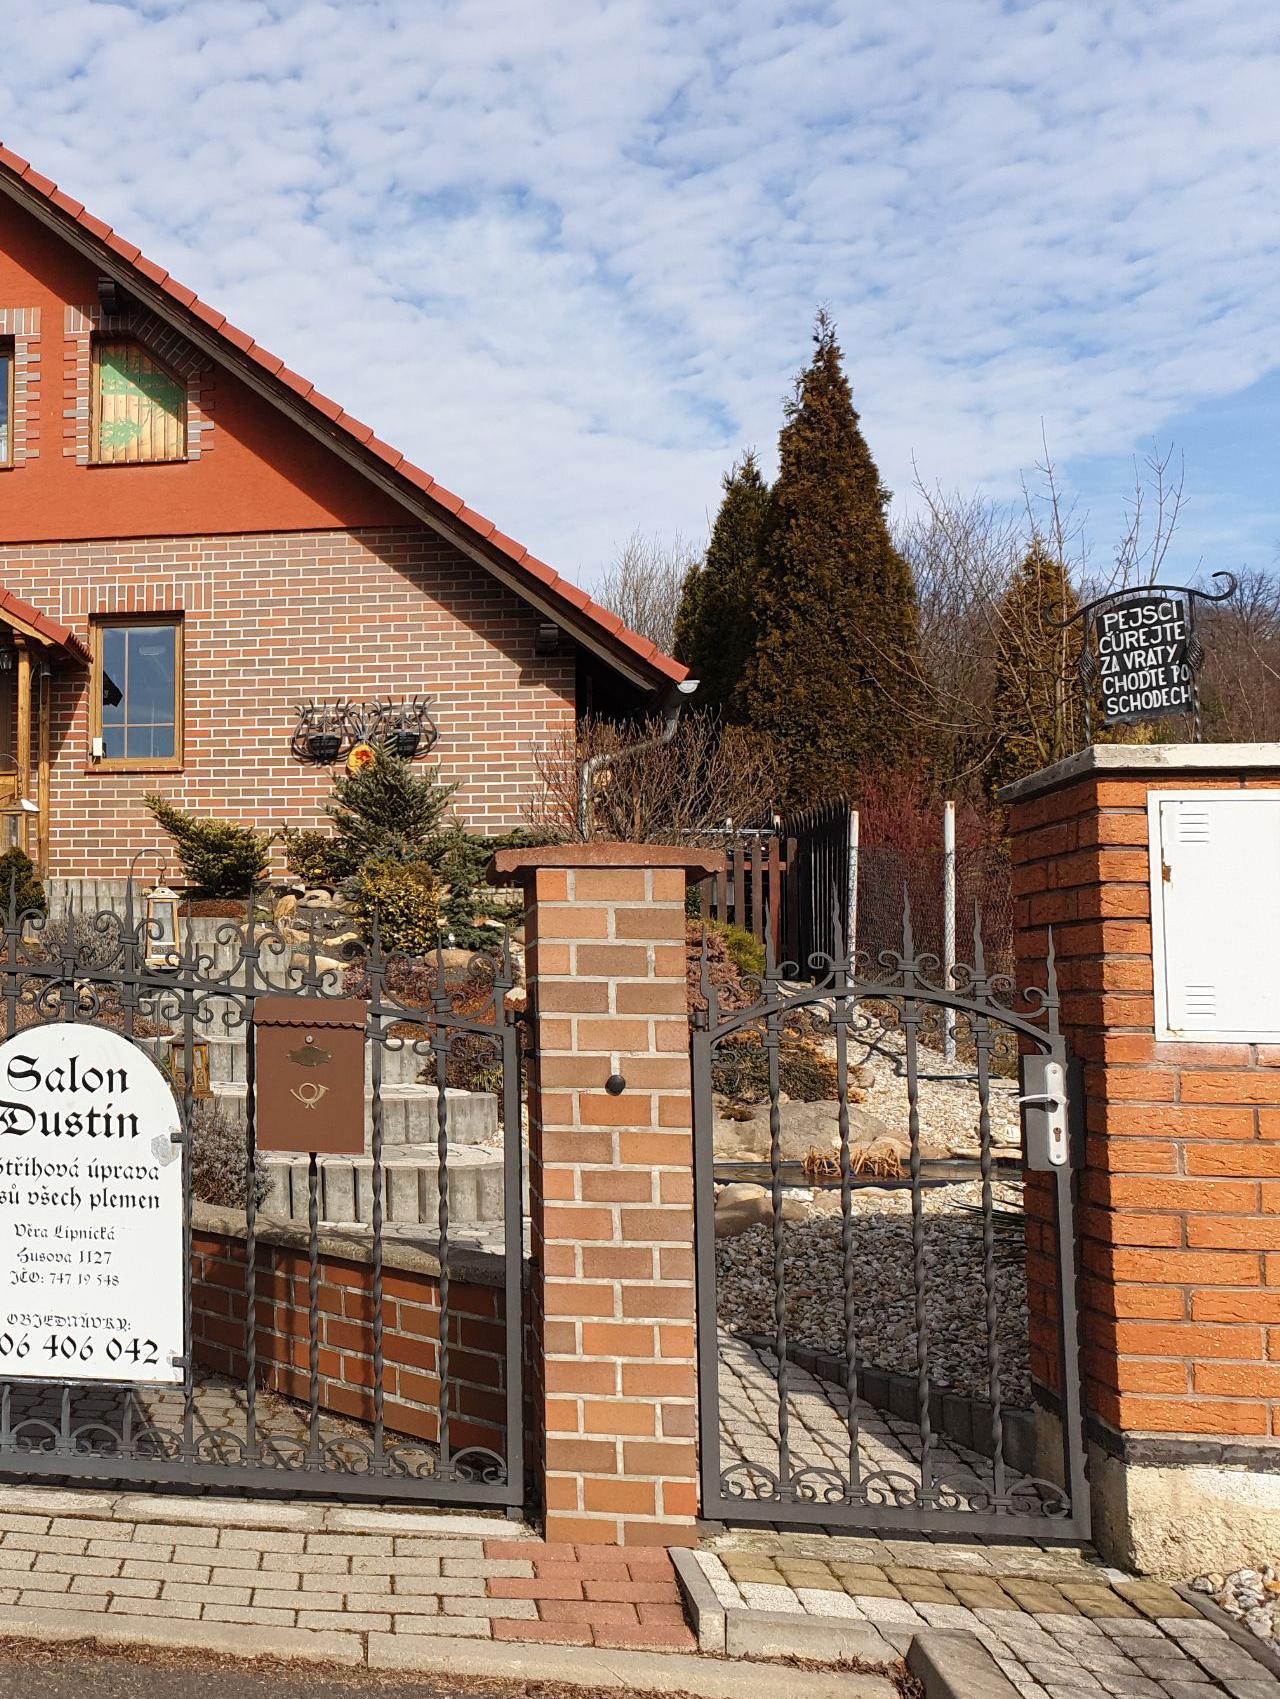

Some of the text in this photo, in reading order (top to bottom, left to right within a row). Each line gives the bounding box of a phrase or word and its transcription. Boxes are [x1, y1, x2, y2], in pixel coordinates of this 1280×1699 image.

[1102, 601, 1178, 632] PEJSCI
[1100, 655, 1121, 675] ZA
[1106, 685, 1192, 715] SCHODECH
[7, 1054, 129, 1093] Salon
[88, 1157, 160, 1183] úprava
[27, 1185, 81, 1211] všech
[89, 1187, 160, 1211] plemen
[14, 1223, 115, 1242] Věra Lipnická
[16, 1247, 112, 1264] Husova 1127
[49, 1272, 72, 1284] 747
[78, 1273, 91, 1286] 19
[96, 1273, 120, 1287] 548
[6, 1312, 131, 1332] OBJEDNÁVKY:
[42, 1334, 94, 1361] 406
[105, 1337, 160, 1365] 042
